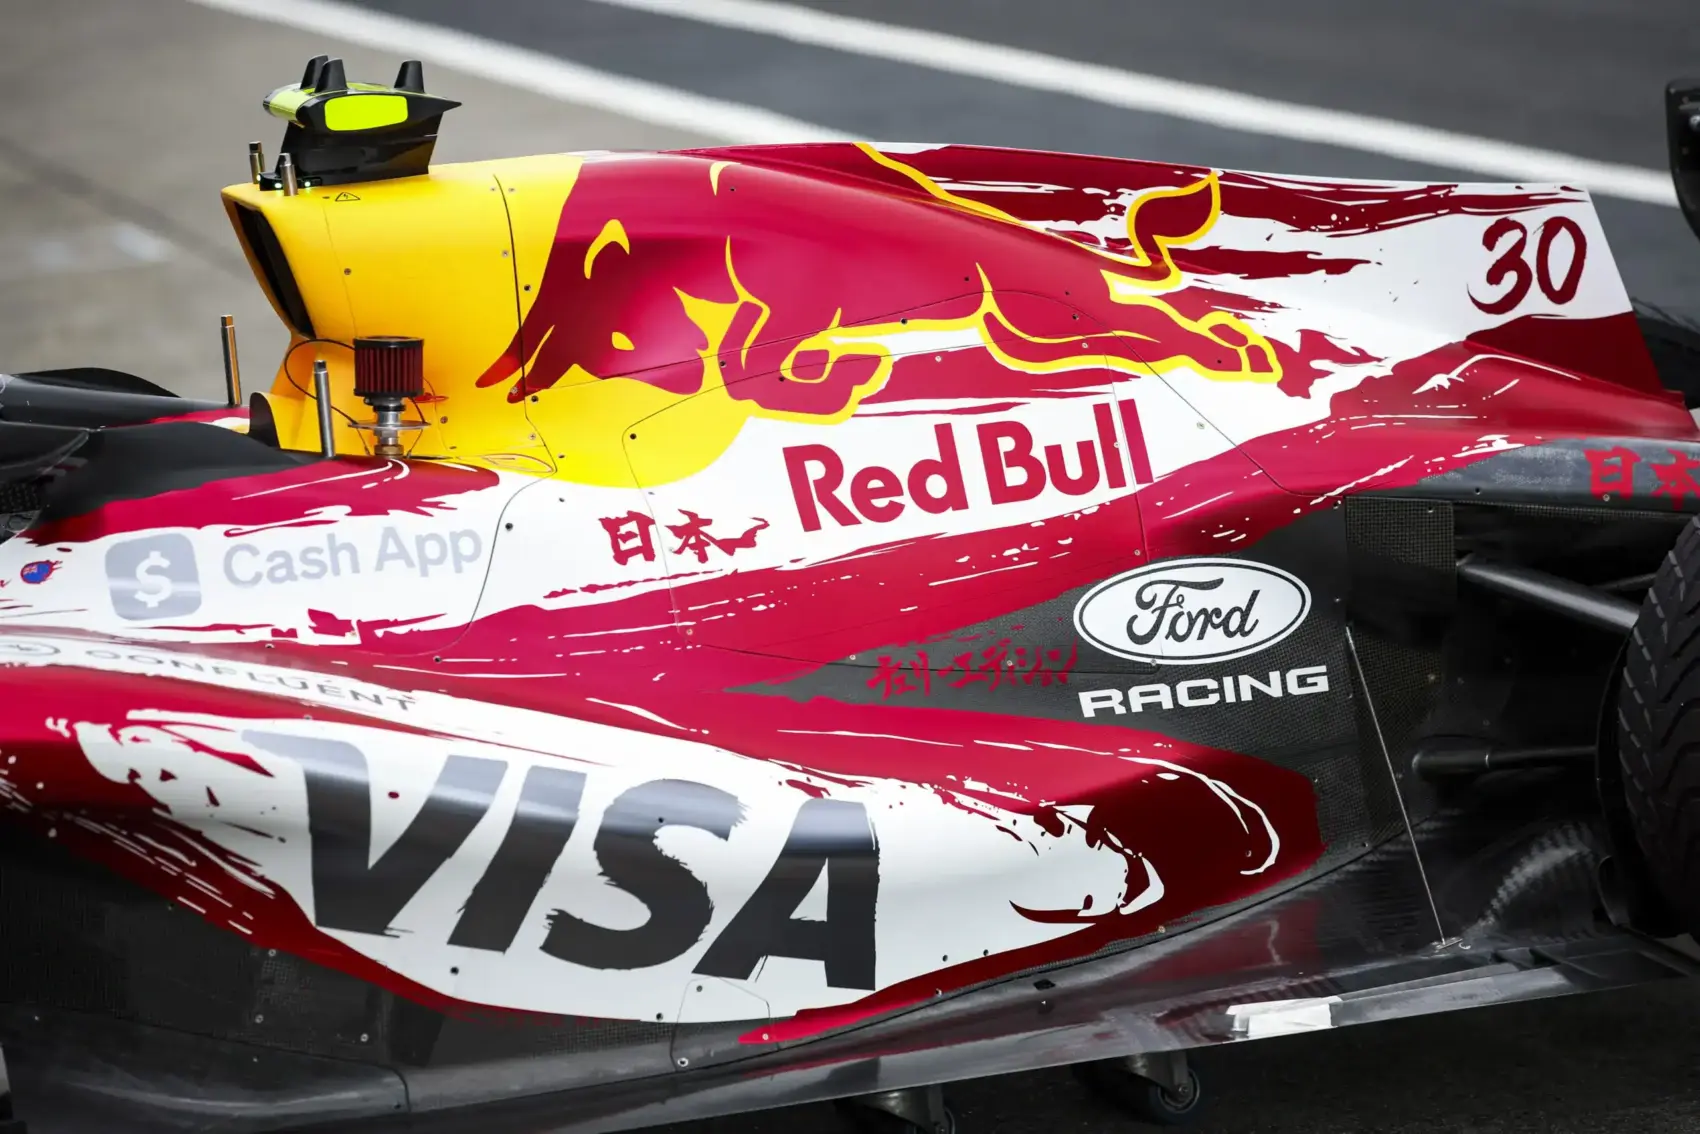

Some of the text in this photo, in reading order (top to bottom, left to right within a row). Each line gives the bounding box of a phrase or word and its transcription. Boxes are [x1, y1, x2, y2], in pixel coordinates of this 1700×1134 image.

[1467, 217, 1587, 315] 30
[782, 398, 1153, 532] Red Bull
[1583, 445, 1700, 511] 日本
[223, 525, 482, 589] Cash App
[598, 508, 770, 566] 日本
[1126, 578, 1260, 644] Ford
[1079, 665, 1330, 719] RACING
[241, 729, 881, 991] VISA
